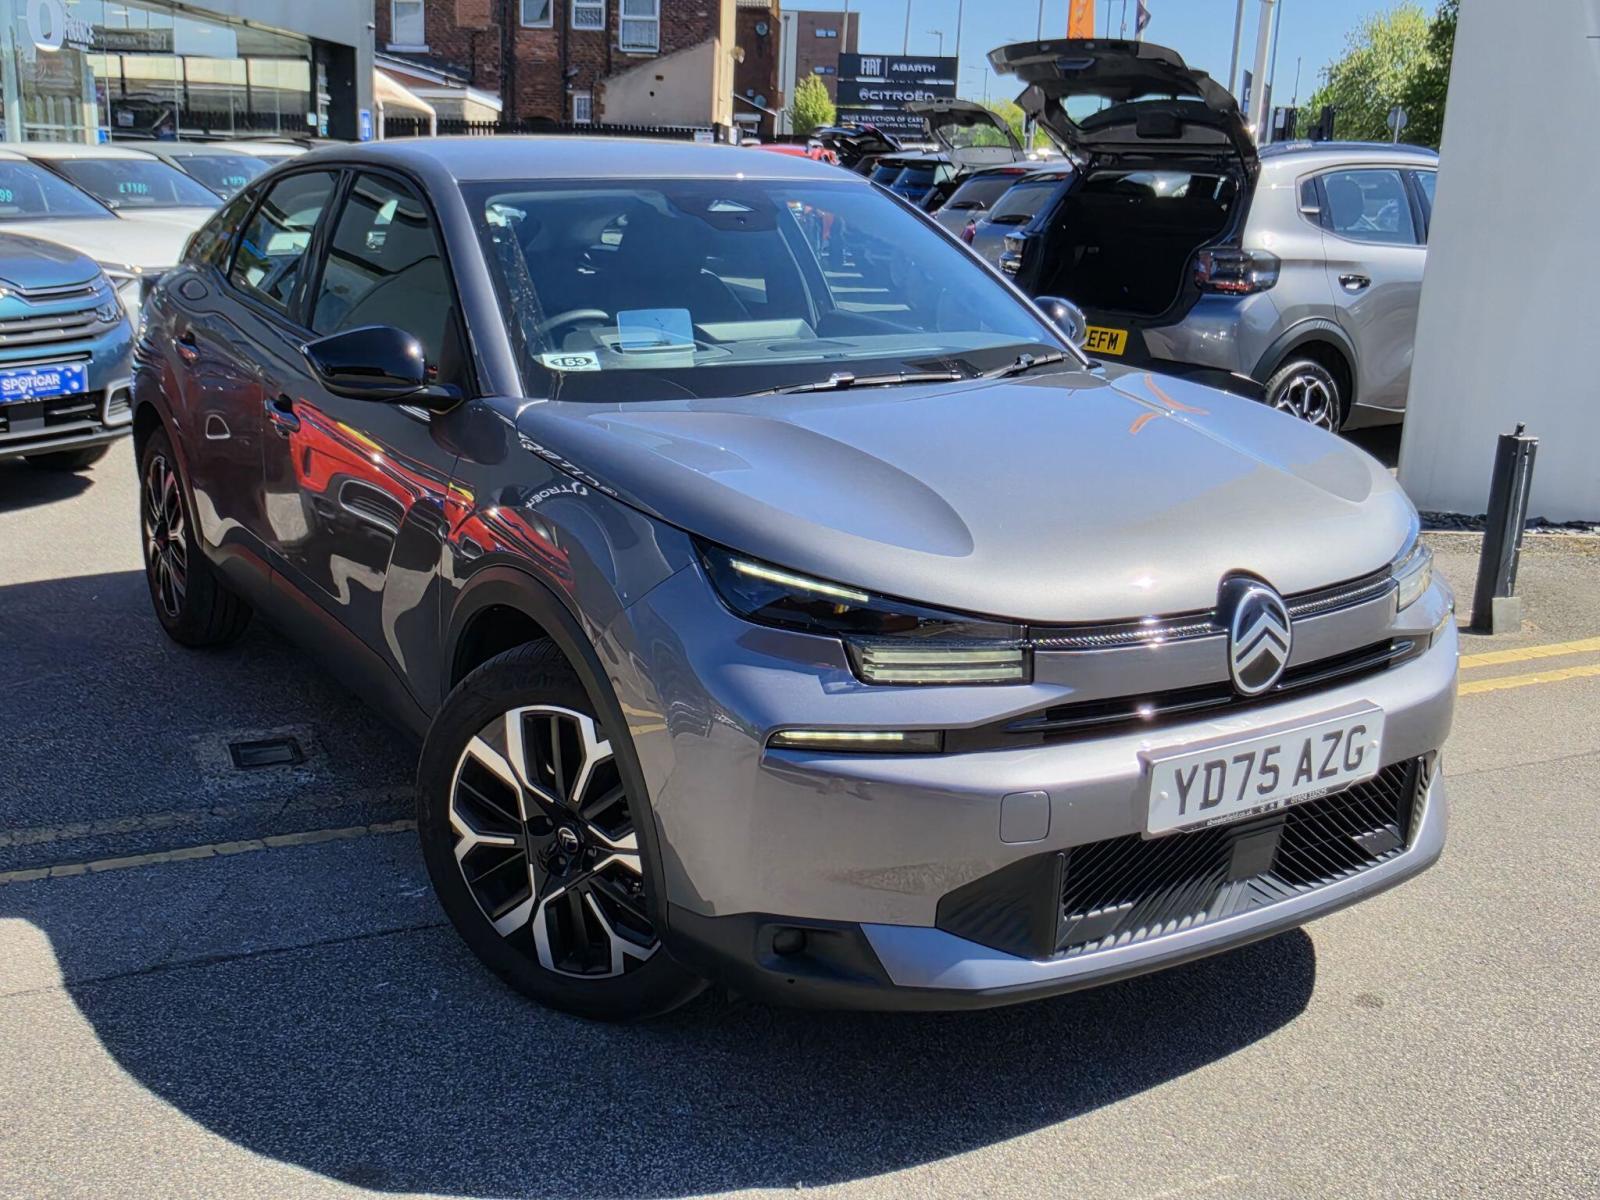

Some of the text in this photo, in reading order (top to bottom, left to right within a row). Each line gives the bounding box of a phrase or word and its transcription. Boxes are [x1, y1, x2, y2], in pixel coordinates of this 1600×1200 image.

[861, 58, 936, 76] FIAT ABARTH
[1087, 330, 1119, 350] EFM
[2, 374, 61, 393] SPOTICAR
[1174, 725, 1366, 816] YD75 AZG
